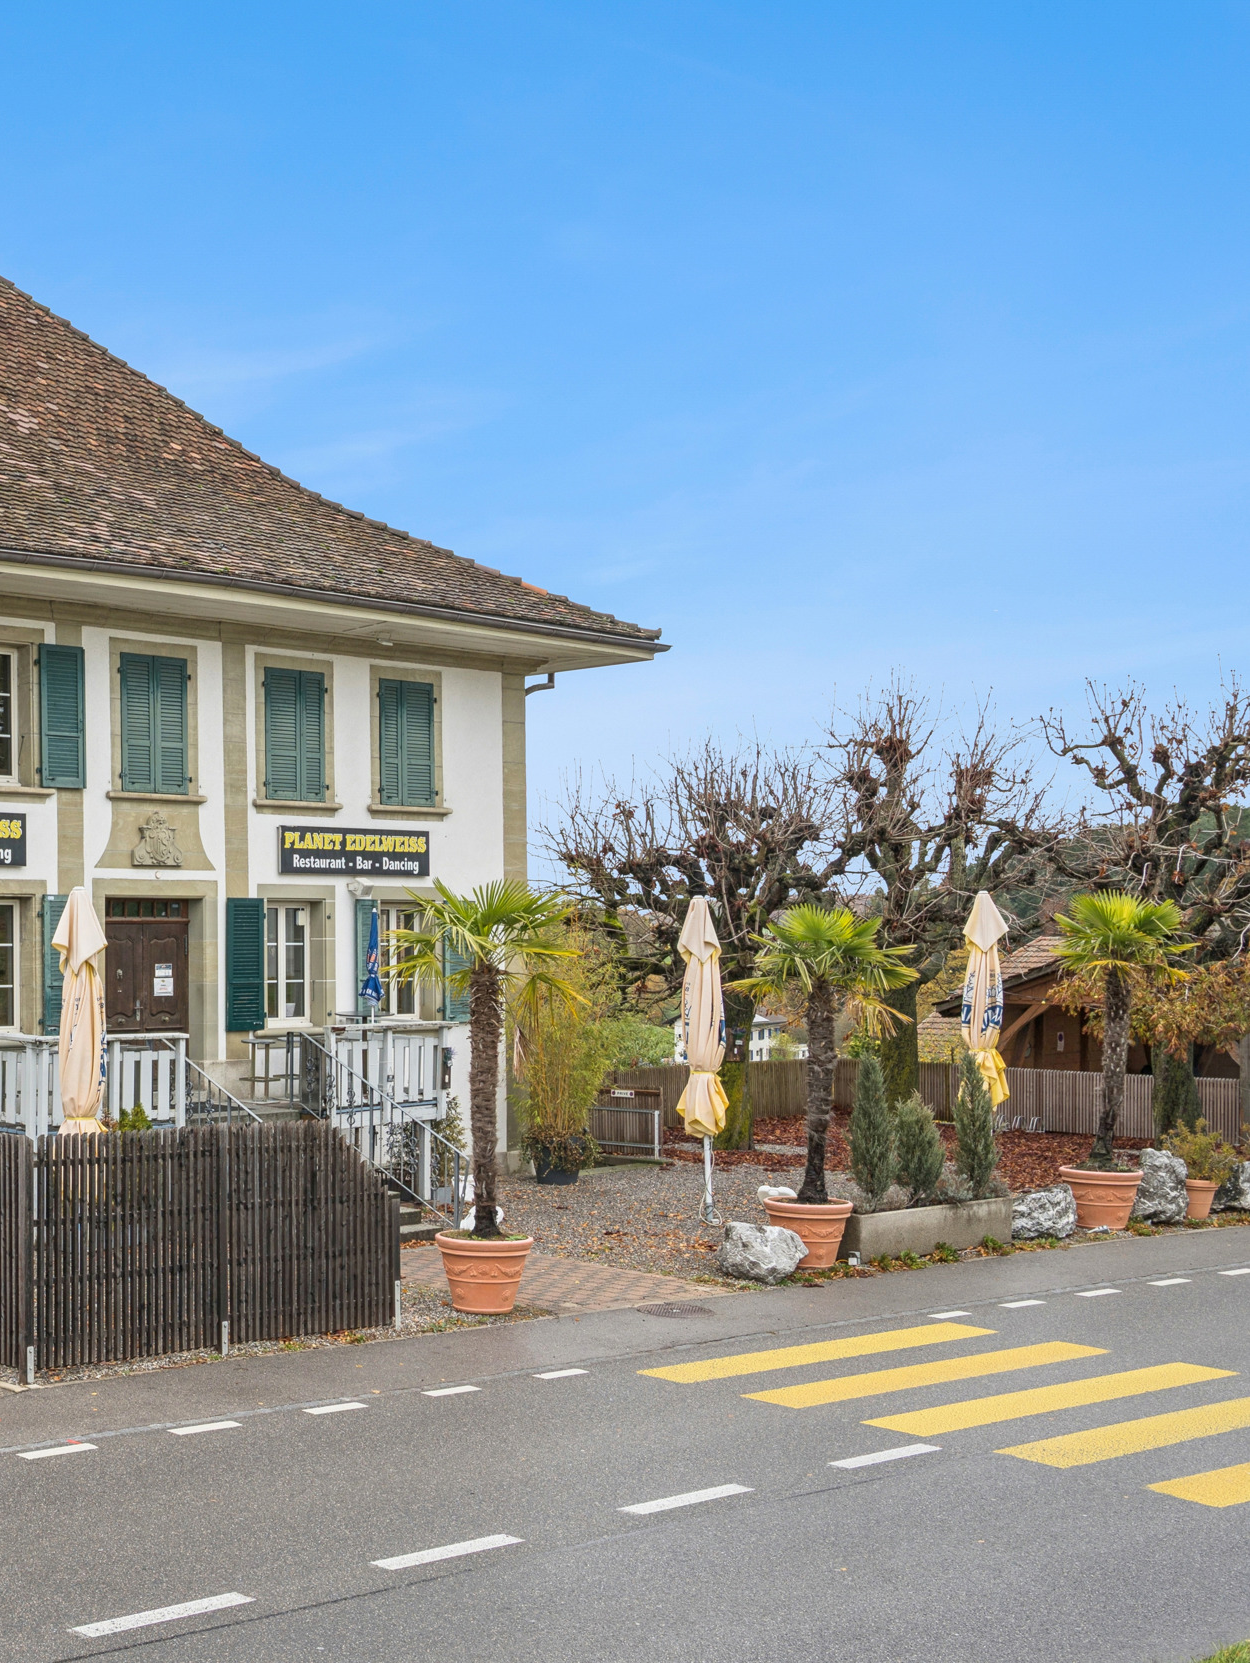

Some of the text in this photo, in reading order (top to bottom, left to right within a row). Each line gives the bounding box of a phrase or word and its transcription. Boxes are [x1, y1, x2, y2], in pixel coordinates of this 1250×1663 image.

[284, 831, 427, 853] PLANET EDELWEISS
[293, 854, 345, 869] Restaurant
[356, 856, 372, 870] Bar
[382, 857, 419, 874] Dancing
